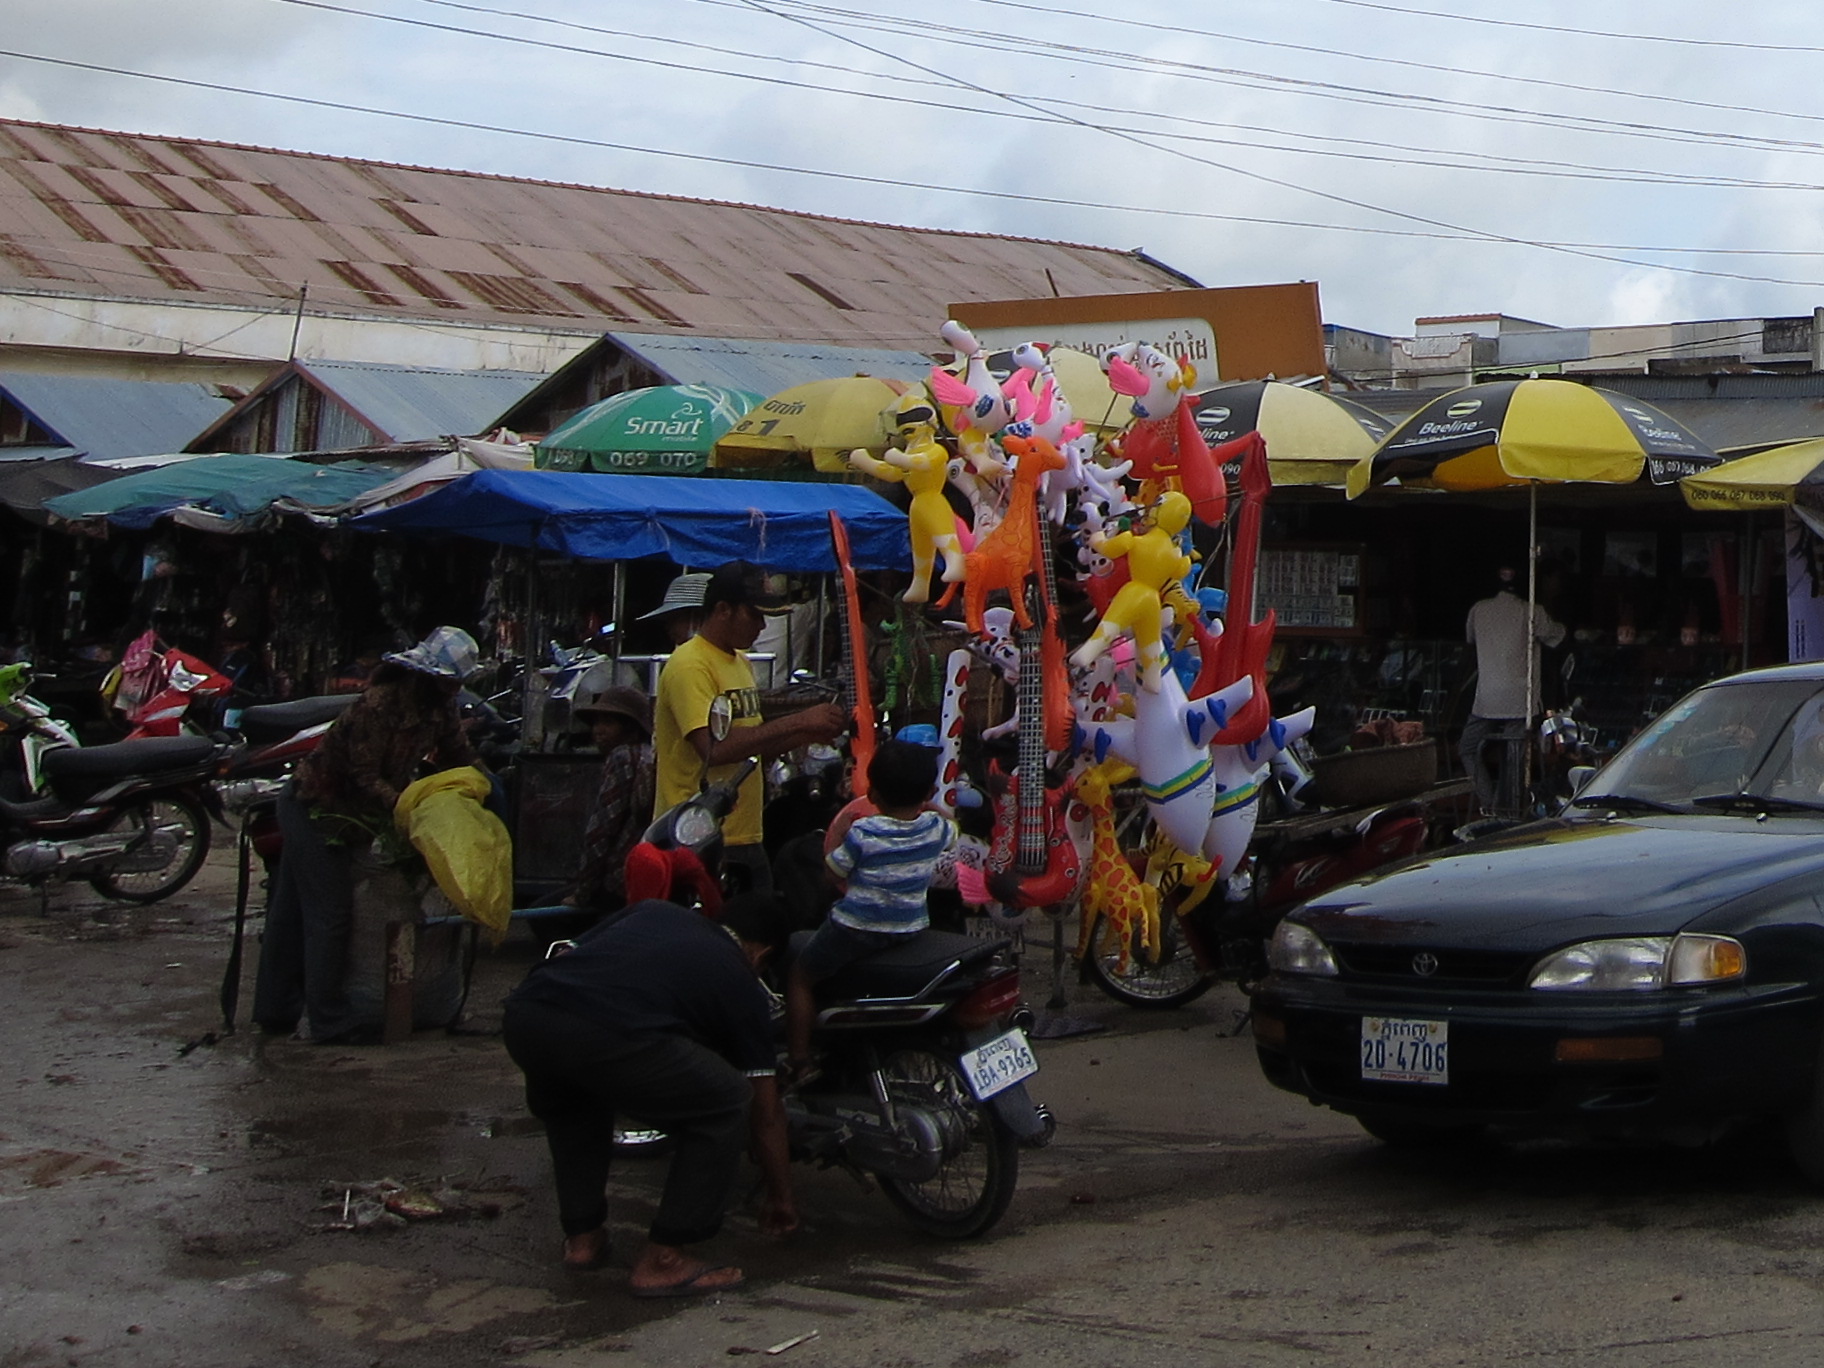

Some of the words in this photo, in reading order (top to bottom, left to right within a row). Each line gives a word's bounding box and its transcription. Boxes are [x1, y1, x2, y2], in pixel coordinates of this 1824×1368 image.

[624, 417, 703, 435] Smart
[760, 419, 781, 436] 1
[1418, 420, 1478, 436] Beeline
[610, 452, 649, 466] 069
[660, 453, 697, 467] 070
